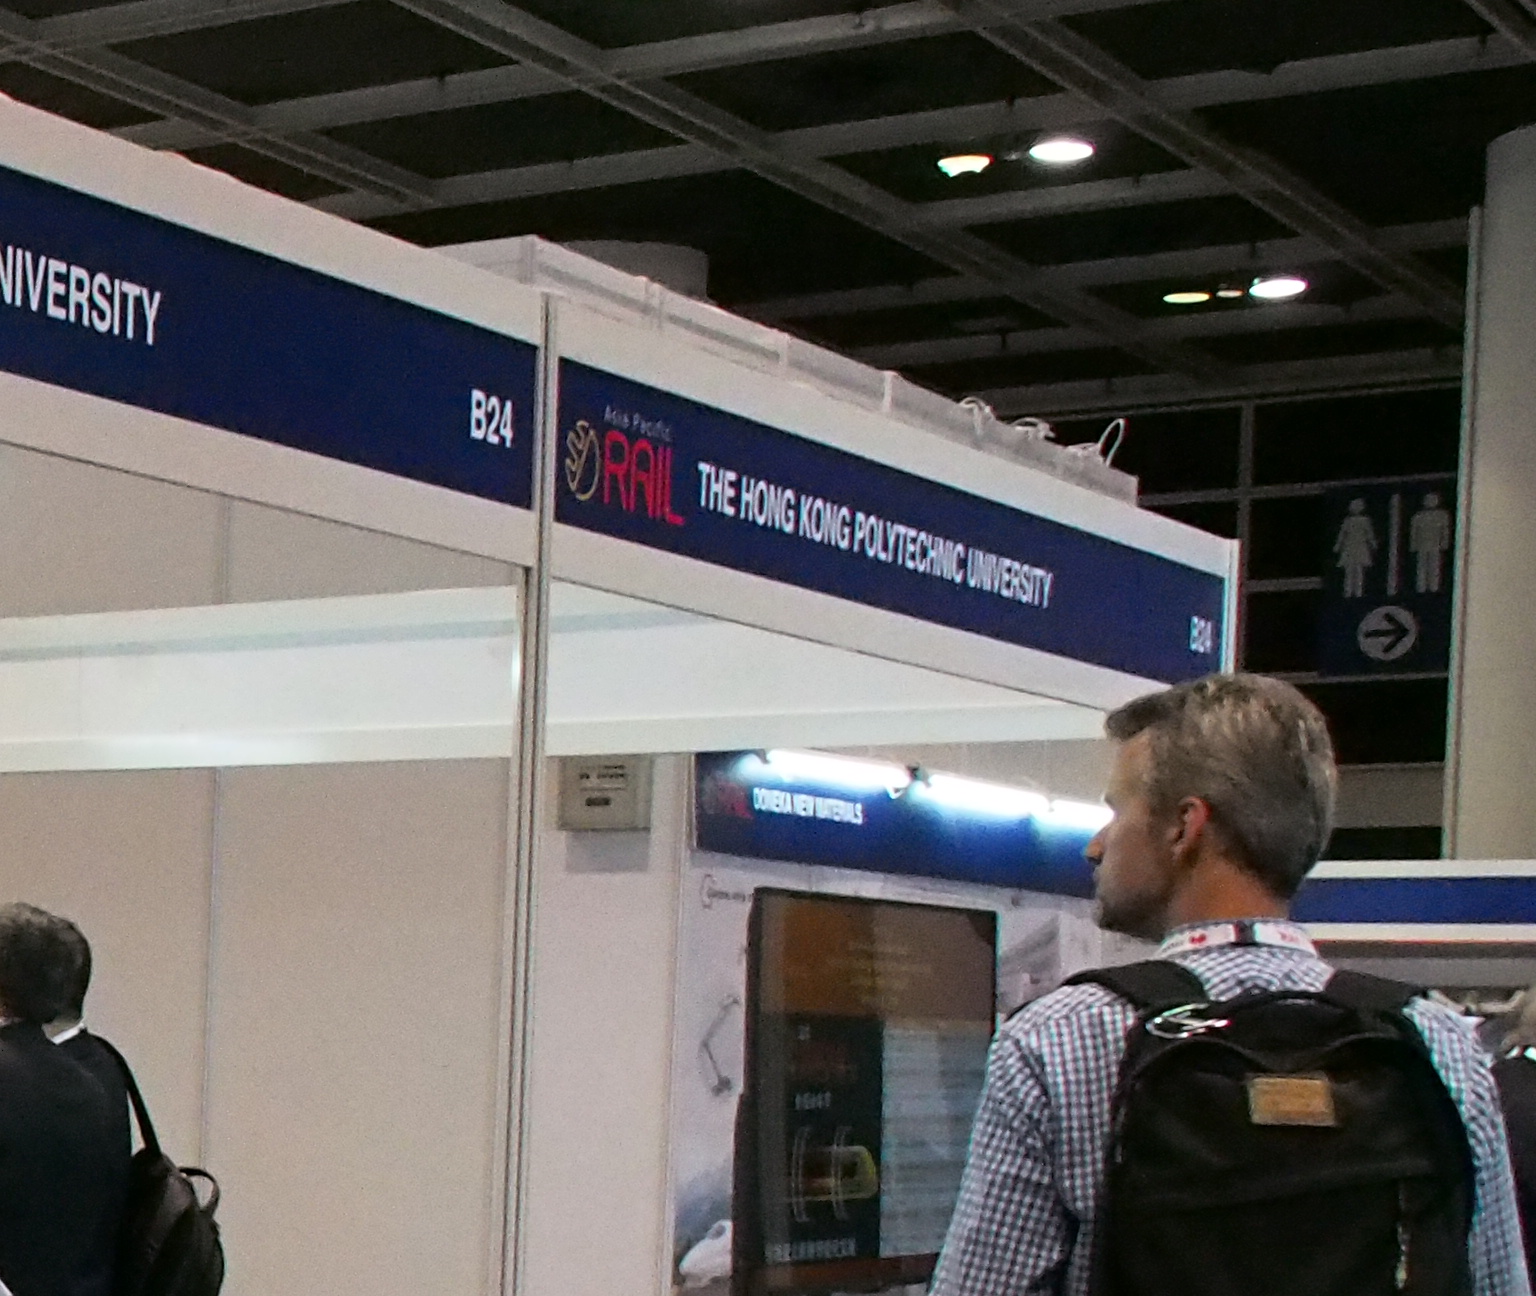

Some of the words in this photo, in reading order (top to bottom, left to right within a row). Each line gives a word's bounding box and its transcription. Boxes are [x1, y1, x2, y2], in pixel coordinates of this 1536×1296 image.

[469, 388, 513, 448] B24
[604, 405, 629, 428] Asia
[604, 430, 686, 525] RAIL
[697, 461, 737, 517] THE
[740, 474, 795, 534] HONG
[798, 492, 852, 552] KONG
[853, 511, 966, 584] POLYTECHNIC
[967, 547, 1055, 609] UNIVERSITY
[1189, 615, 1212, 655] B24
